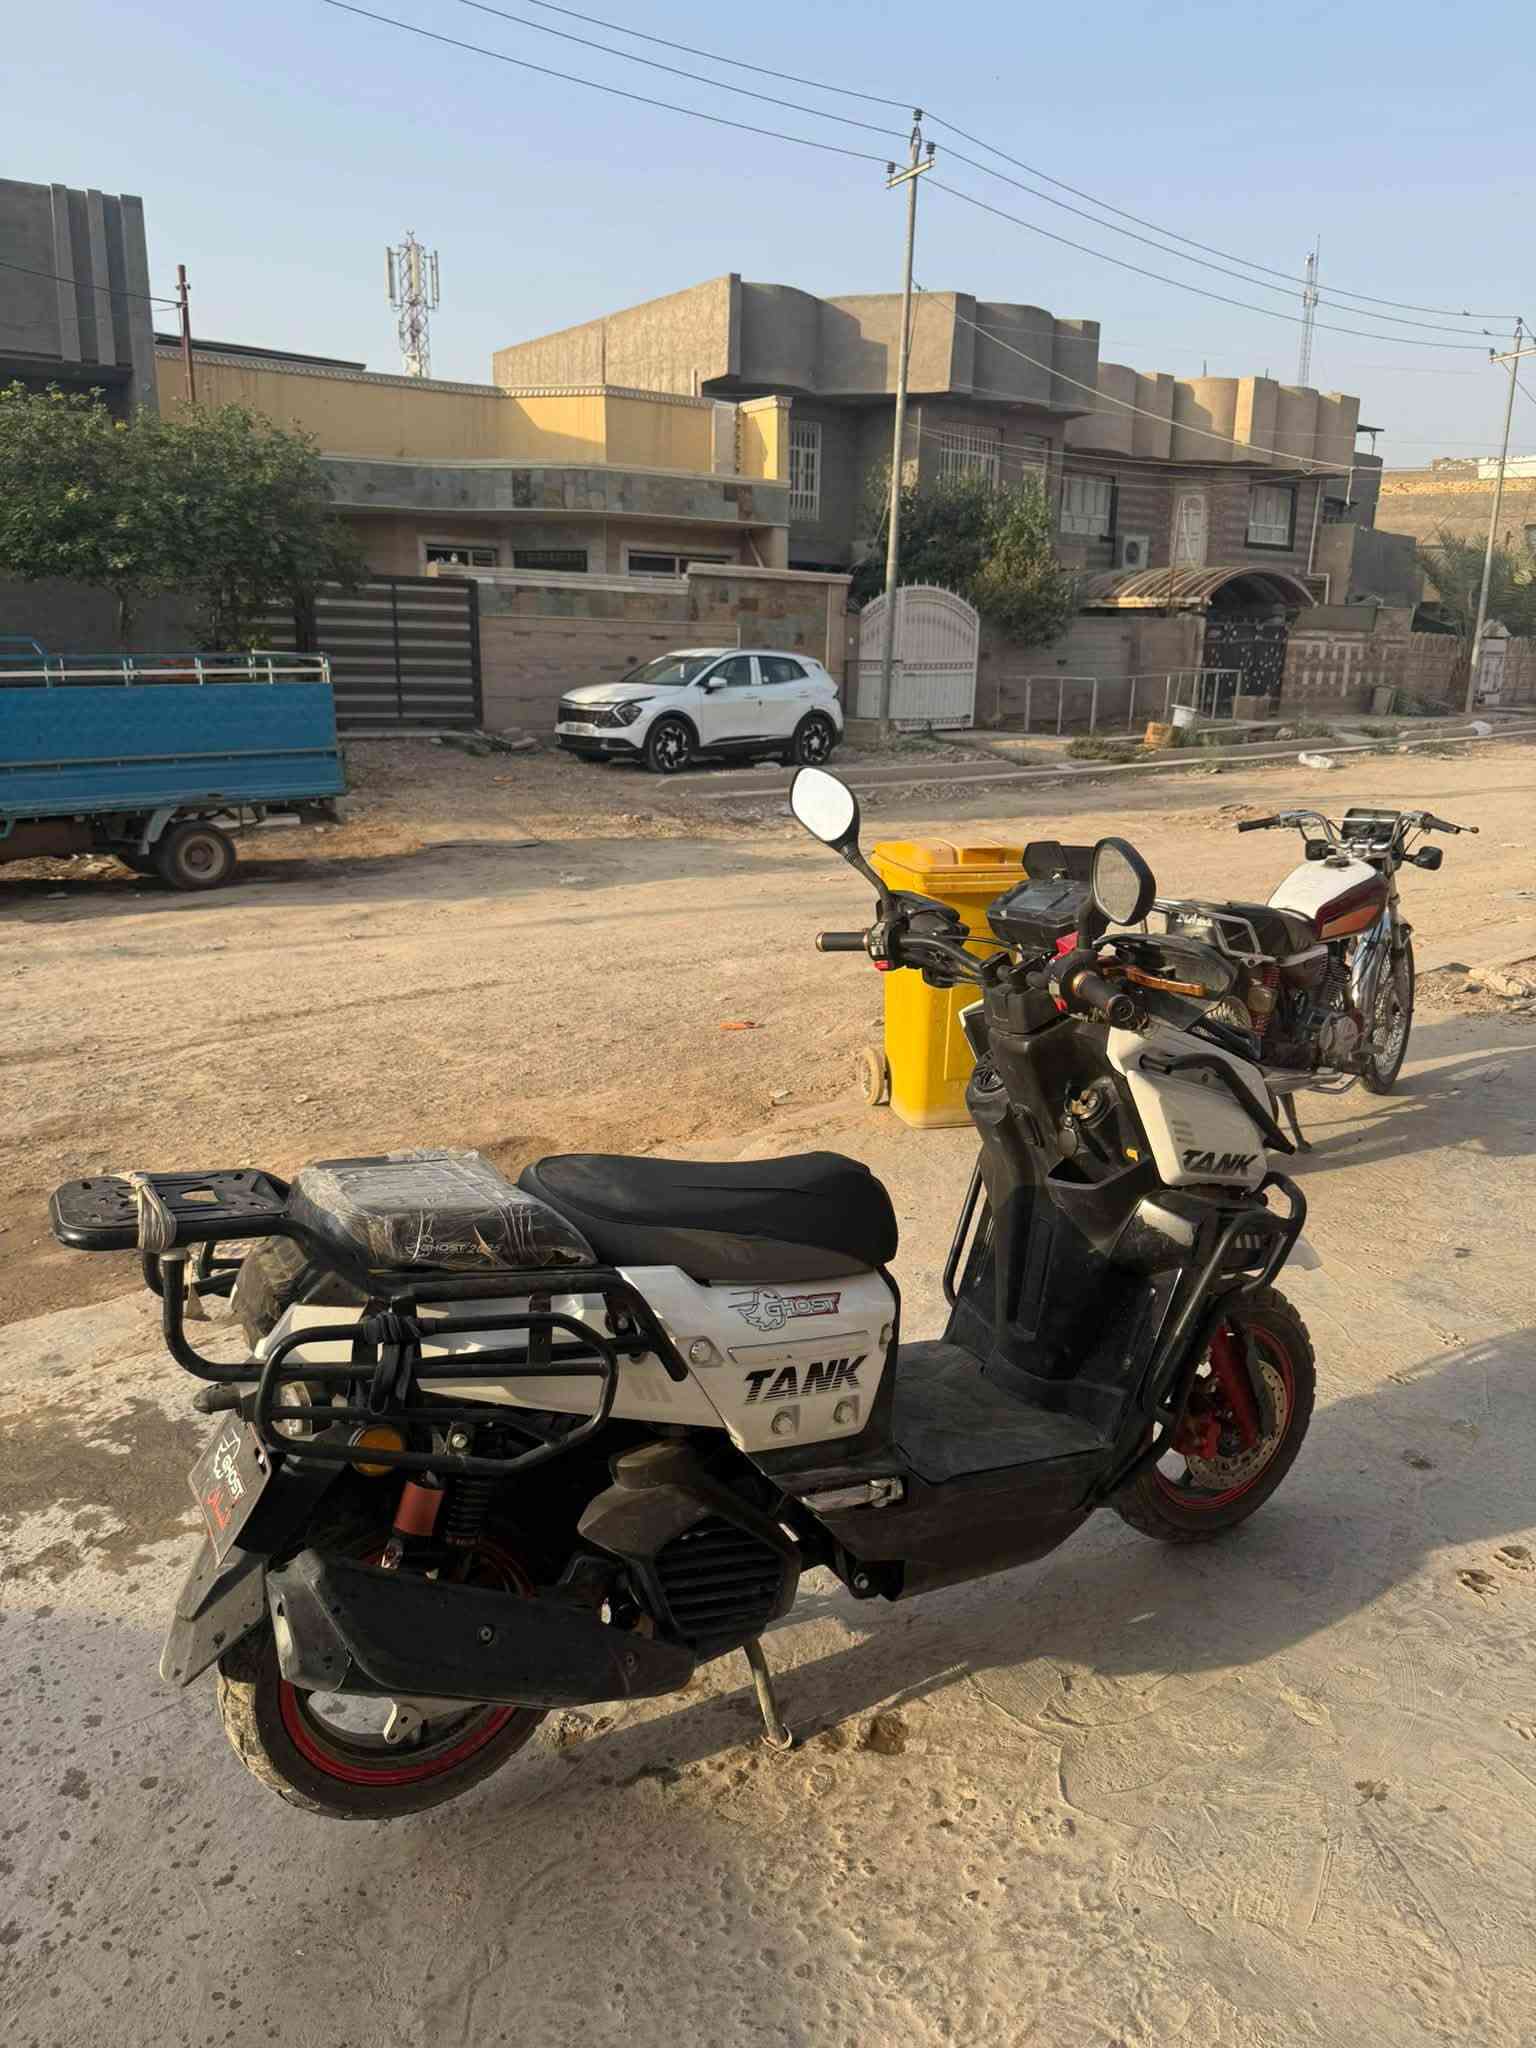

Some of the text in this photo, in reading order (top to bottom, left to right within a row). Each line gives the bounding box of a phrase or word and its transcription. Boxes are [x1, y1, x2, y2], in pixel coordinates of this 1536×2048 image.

[1182, 1149, 1258, 1176] TANK
[764, 1298, 836, 1318] GHOST
[745, 1354, 869, 1402] TANK
[222, 1454, 246, 1500] GHOST
